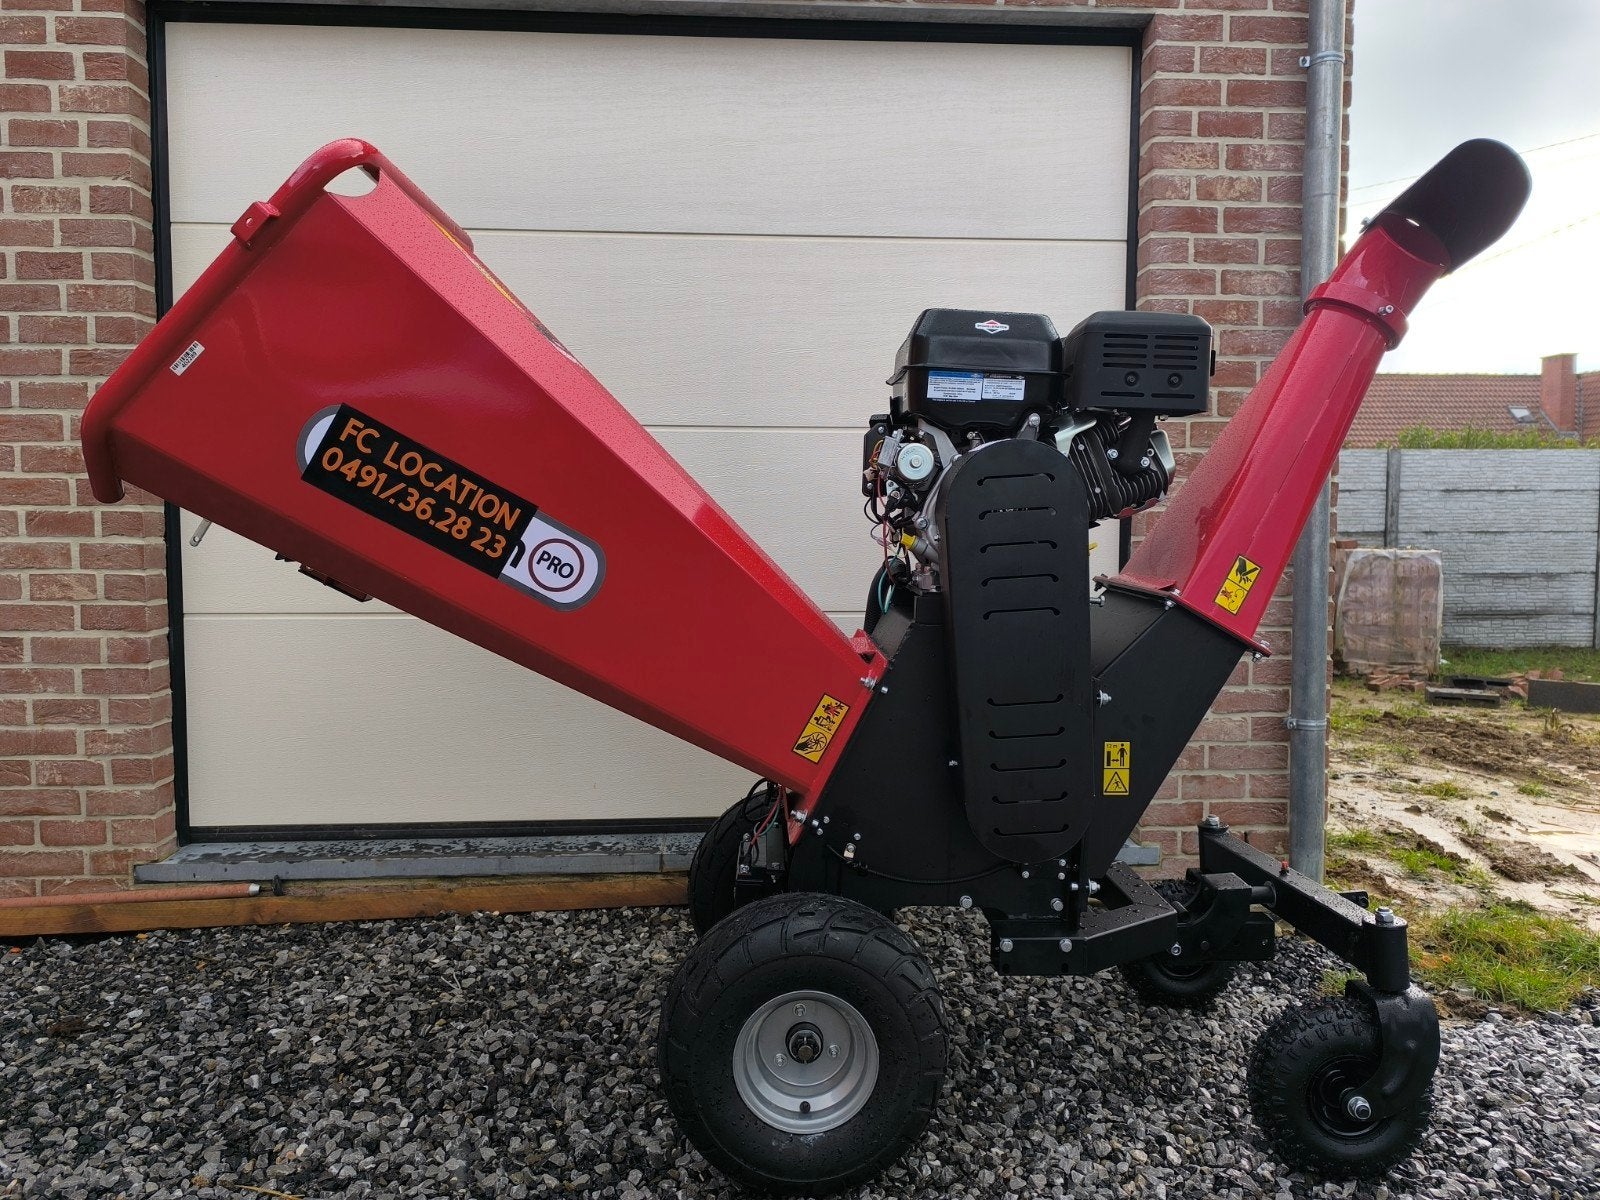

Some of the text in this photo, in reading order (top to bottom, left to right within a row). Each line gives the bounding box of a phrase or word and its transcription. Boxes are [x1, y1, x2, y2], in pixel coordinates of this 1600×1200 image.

[322, 447, 472, 540] 0491/.36.28
[470, 527, 506, 558] 23
[340, 418, 521, 530] FC LOCATION
[536, 550, 574, 579] PRO
